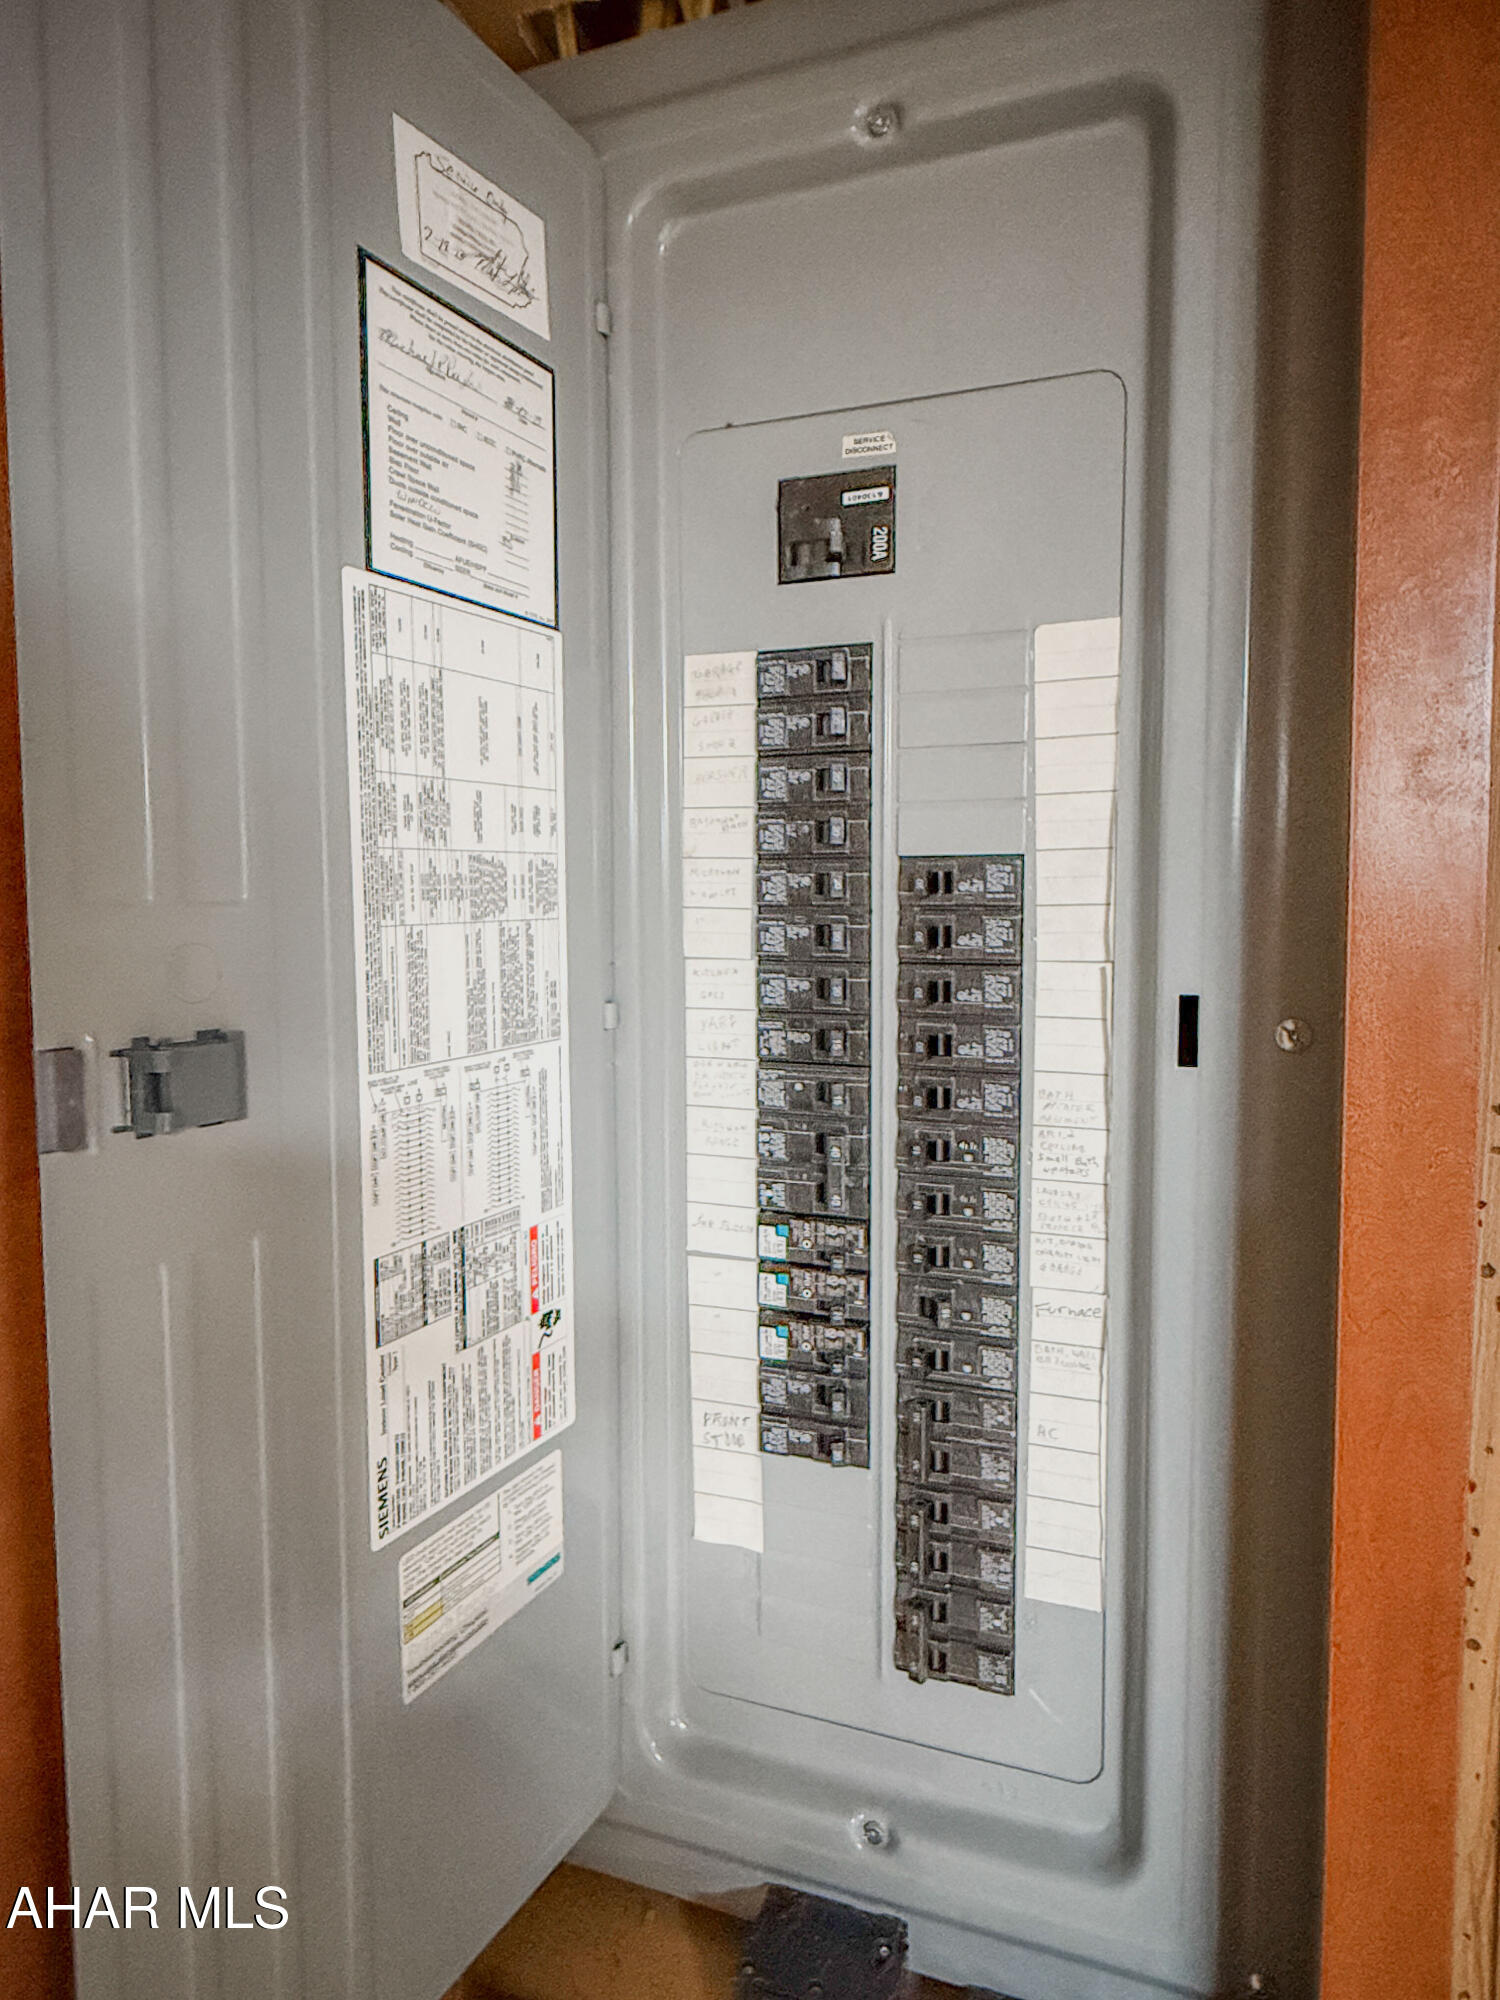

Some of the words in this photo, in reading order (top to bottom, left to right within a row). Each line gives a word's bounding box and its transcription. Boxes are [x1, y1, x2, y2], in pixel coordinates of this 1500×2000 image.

[854, 434, 886, 446] SERVICE
[844, 442, 894, 455] DISCONNECT
[870, 526, 888, 562] 200A
[1034, 1302, 1102, 1318] Furnace
[378, 1456, 391, 1540] SIEMENS
